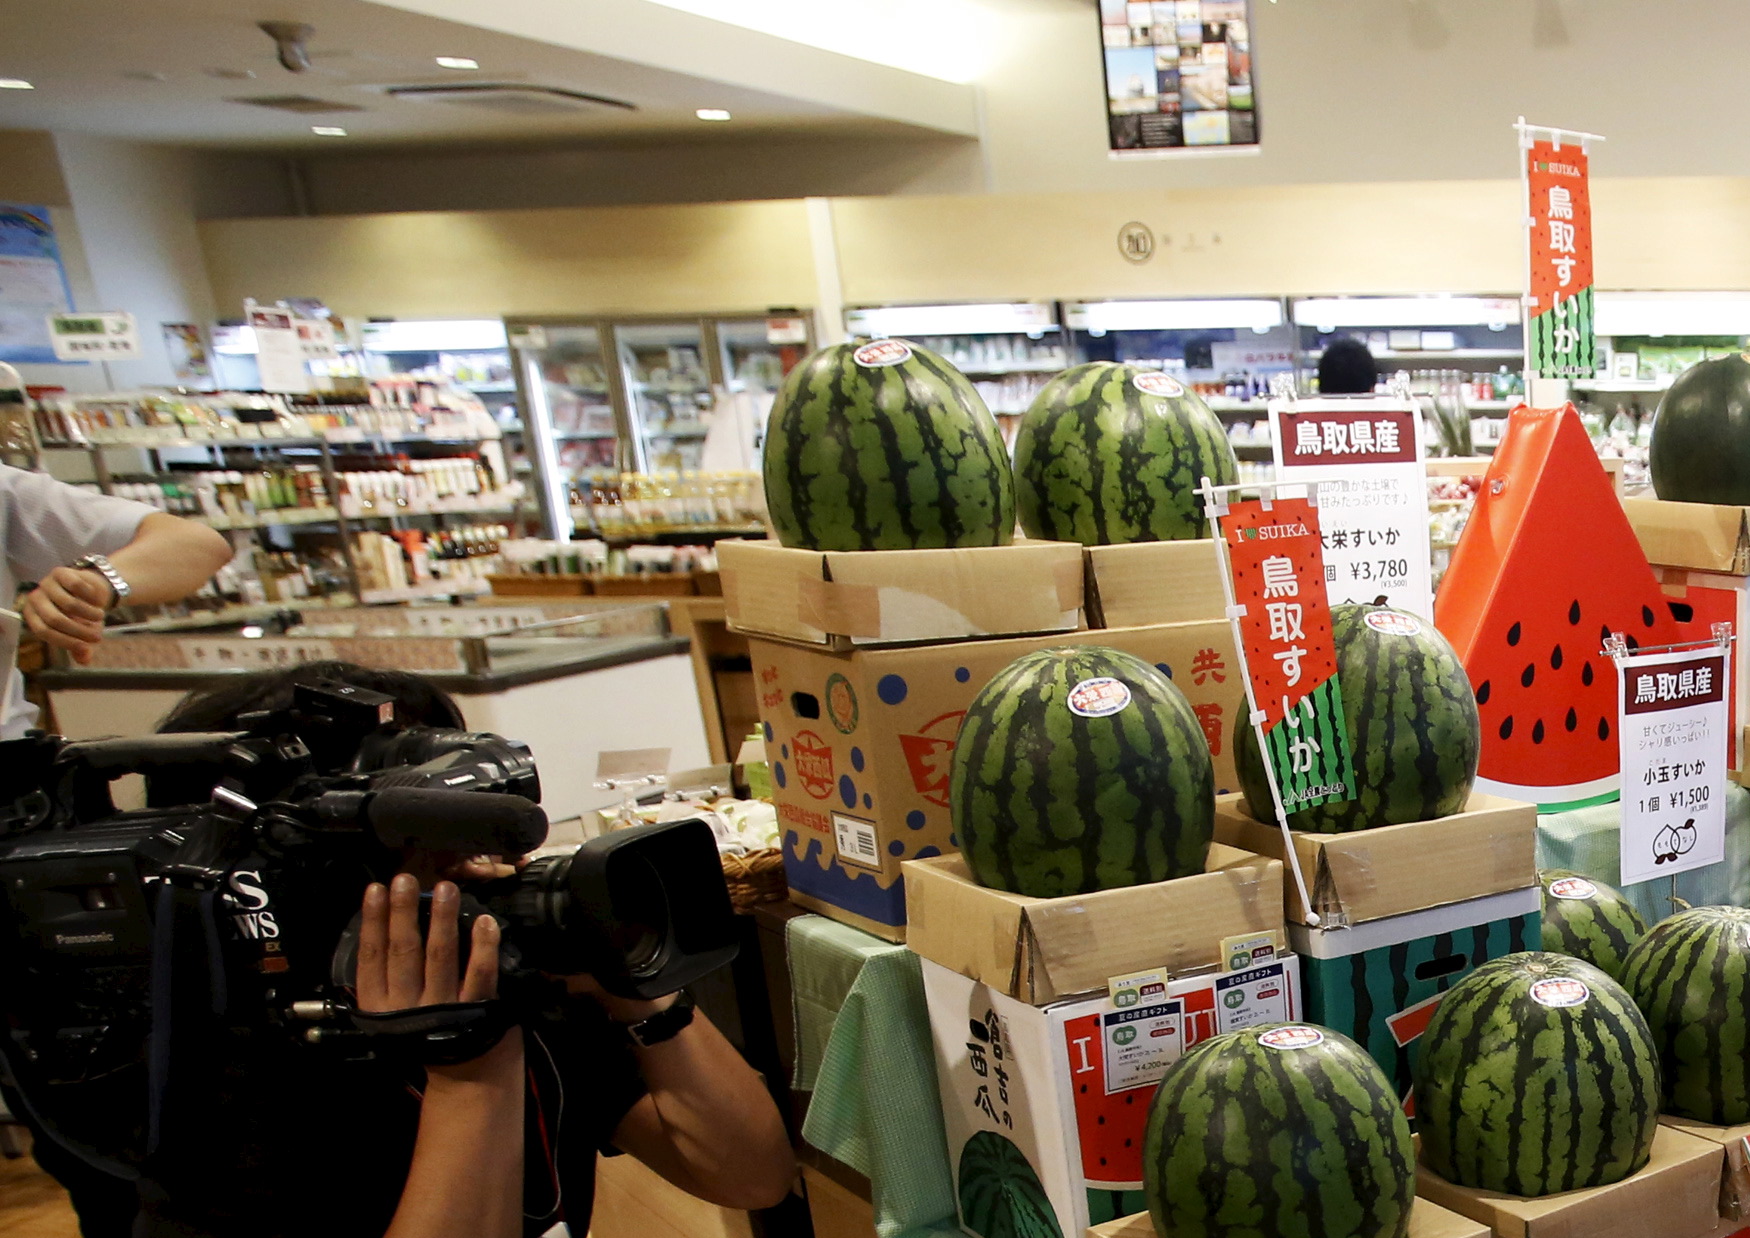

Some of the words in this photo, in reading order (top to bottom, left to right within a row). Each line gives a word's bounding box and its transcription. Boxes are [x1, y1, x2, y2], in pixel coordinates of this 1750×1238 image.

[1548, 162, 1581, 177] SUIKA
[1547, 185, 1580, 354] 鳥取すいか
[1294, 419, 1401, 456] 鳥取県産
[1235, 529, 1245, 543] I
[1258, 523, 1310, 542] SUIKA
[1350, 558, 1408, 581] ¥3,780
[1261, 555, 1321, 775] 鳥取すいか
[1633, 666, 1713, 705] 鳥取県産
[1642, 759, 1706, 786] 小玉すいか
[1669, 785, 1710, 809] ¥1,500
[54, 932, 115, 945] Panasonic
